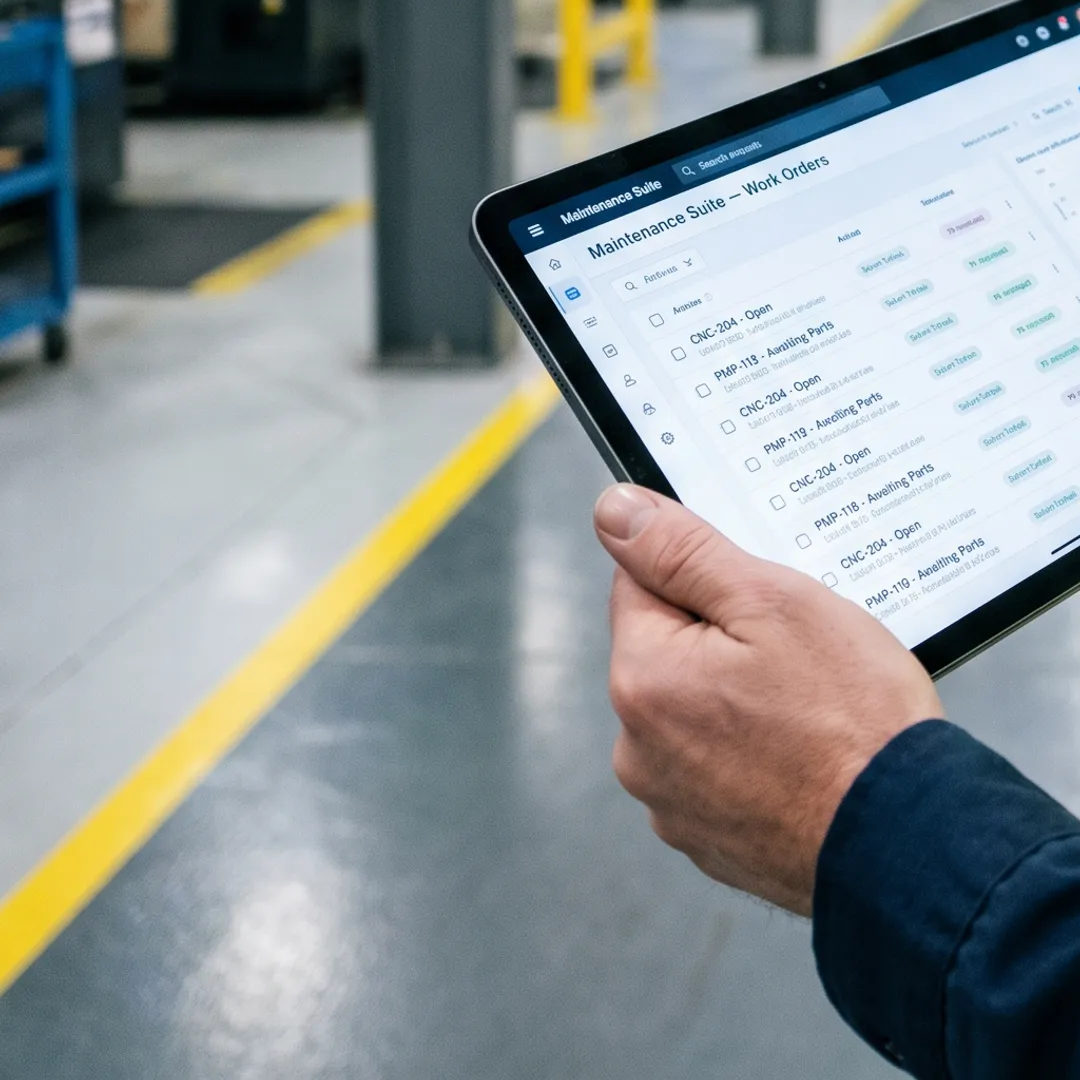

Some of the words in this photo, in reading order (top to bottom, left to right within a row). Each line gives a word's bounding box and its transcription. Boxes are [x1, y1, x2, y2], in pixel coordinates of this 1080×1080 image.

[560, 191, 633, 225] Maintenance
[631, 178, 663, 199] Suite
[587, 213, 687, 260] Maintenance
[686, 197, 726, 220] Suite
[742, 173, 782, 197] Work
[781, 153, 830, 181] Orders
[690, 317, 739, 345] CNC-204
[744, 303, 774, 322] Open
[739, 388, 787, 418] CNC-204
[793, 374, 822, 393] Open
[789, 463, 837, 493] CNC-204
[843, 446, 872, 465] Open
[840, 538, 888, 570] CNC-204
[894, 520, 922, 541] Open
